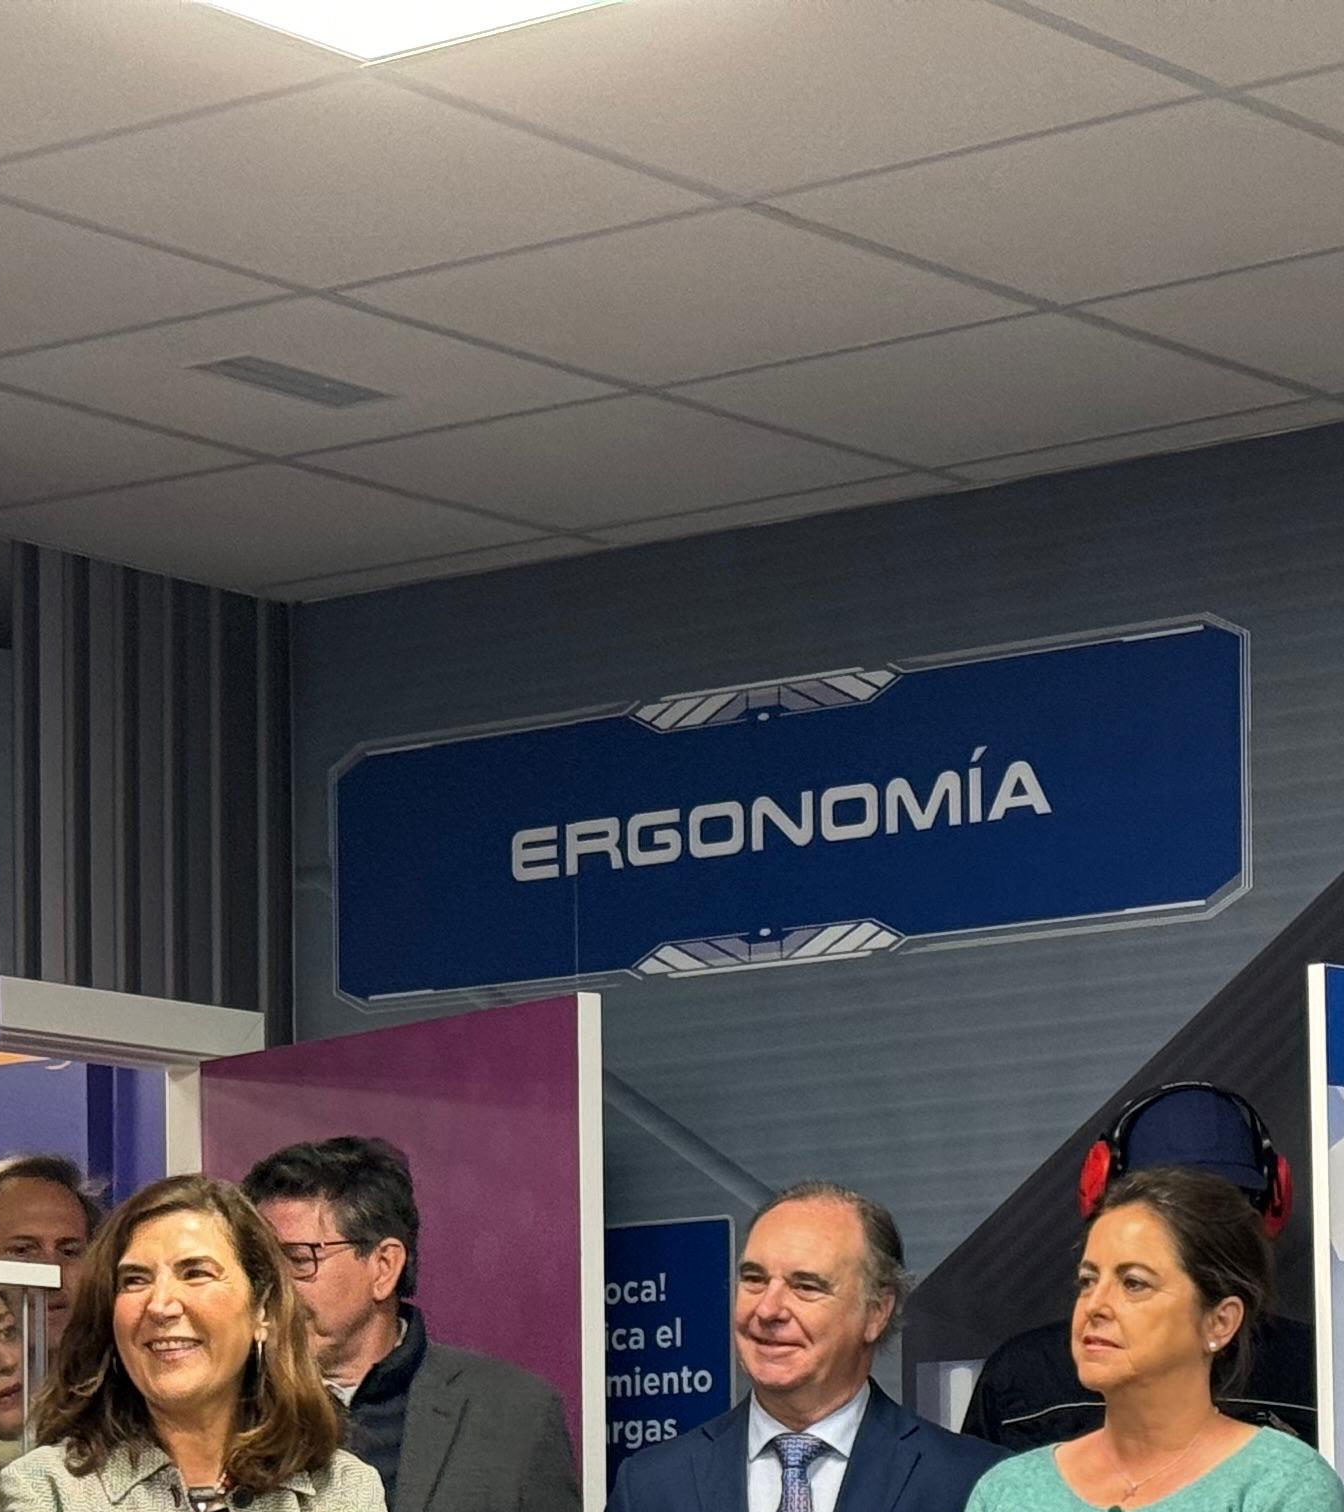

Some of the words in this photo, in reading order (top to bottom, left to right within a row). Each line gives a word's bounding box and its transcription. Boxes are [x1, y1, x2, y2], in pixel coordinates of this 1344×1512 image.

[510, 746, 1052, 882] ERGONOMÍA
[605, 1273, 667, 1305] oca!
[606, 1323, 645, 1350] ica
[656, 1317, 682, 1348] el
[606, 1365, 713, 1397] miento
[606, 1417, 678, 1449] rgas
